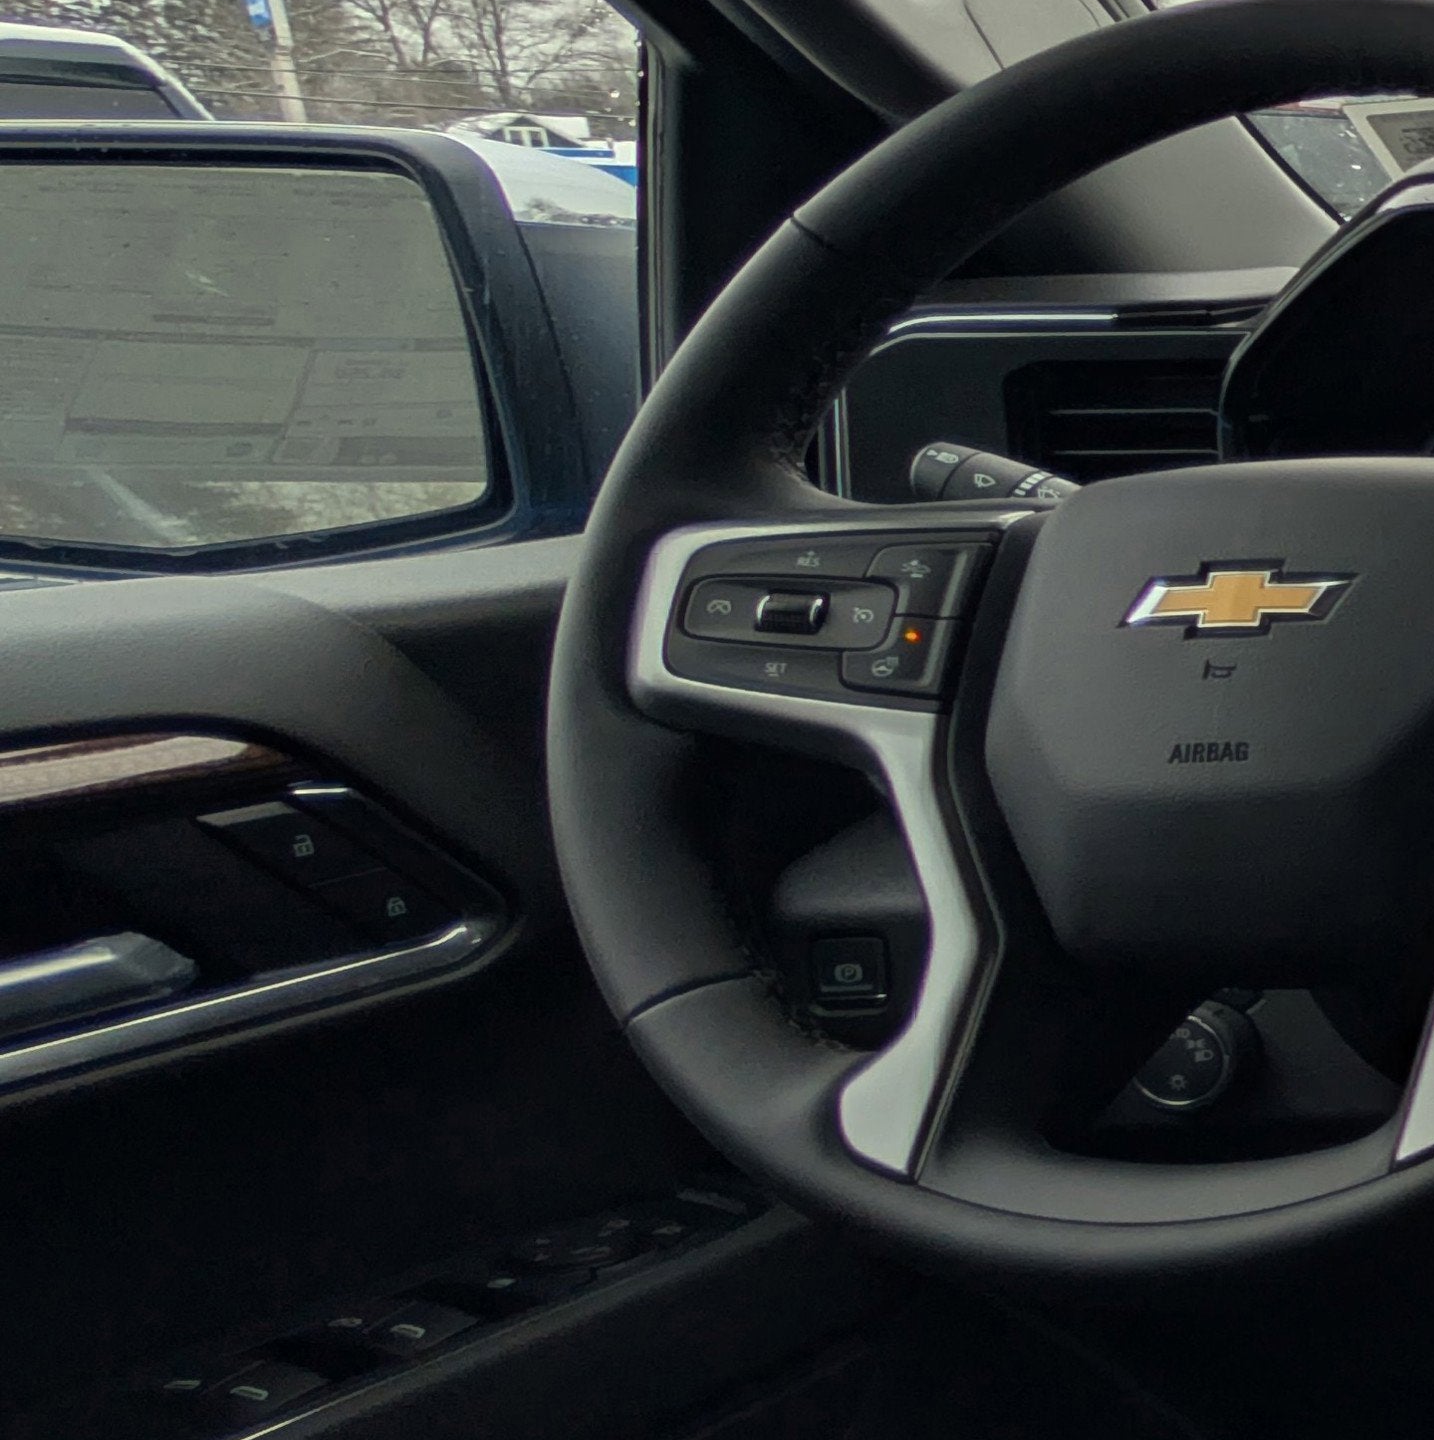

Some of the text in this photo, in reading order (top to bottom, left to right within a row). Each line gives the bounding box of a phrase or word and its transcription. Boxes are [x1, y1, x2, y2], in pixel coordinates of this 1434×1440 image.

[796, 556, 821, 568] RES
[764, 662, 788, 675] SET
[1168, 741, 1250, 763] AIRBAG
